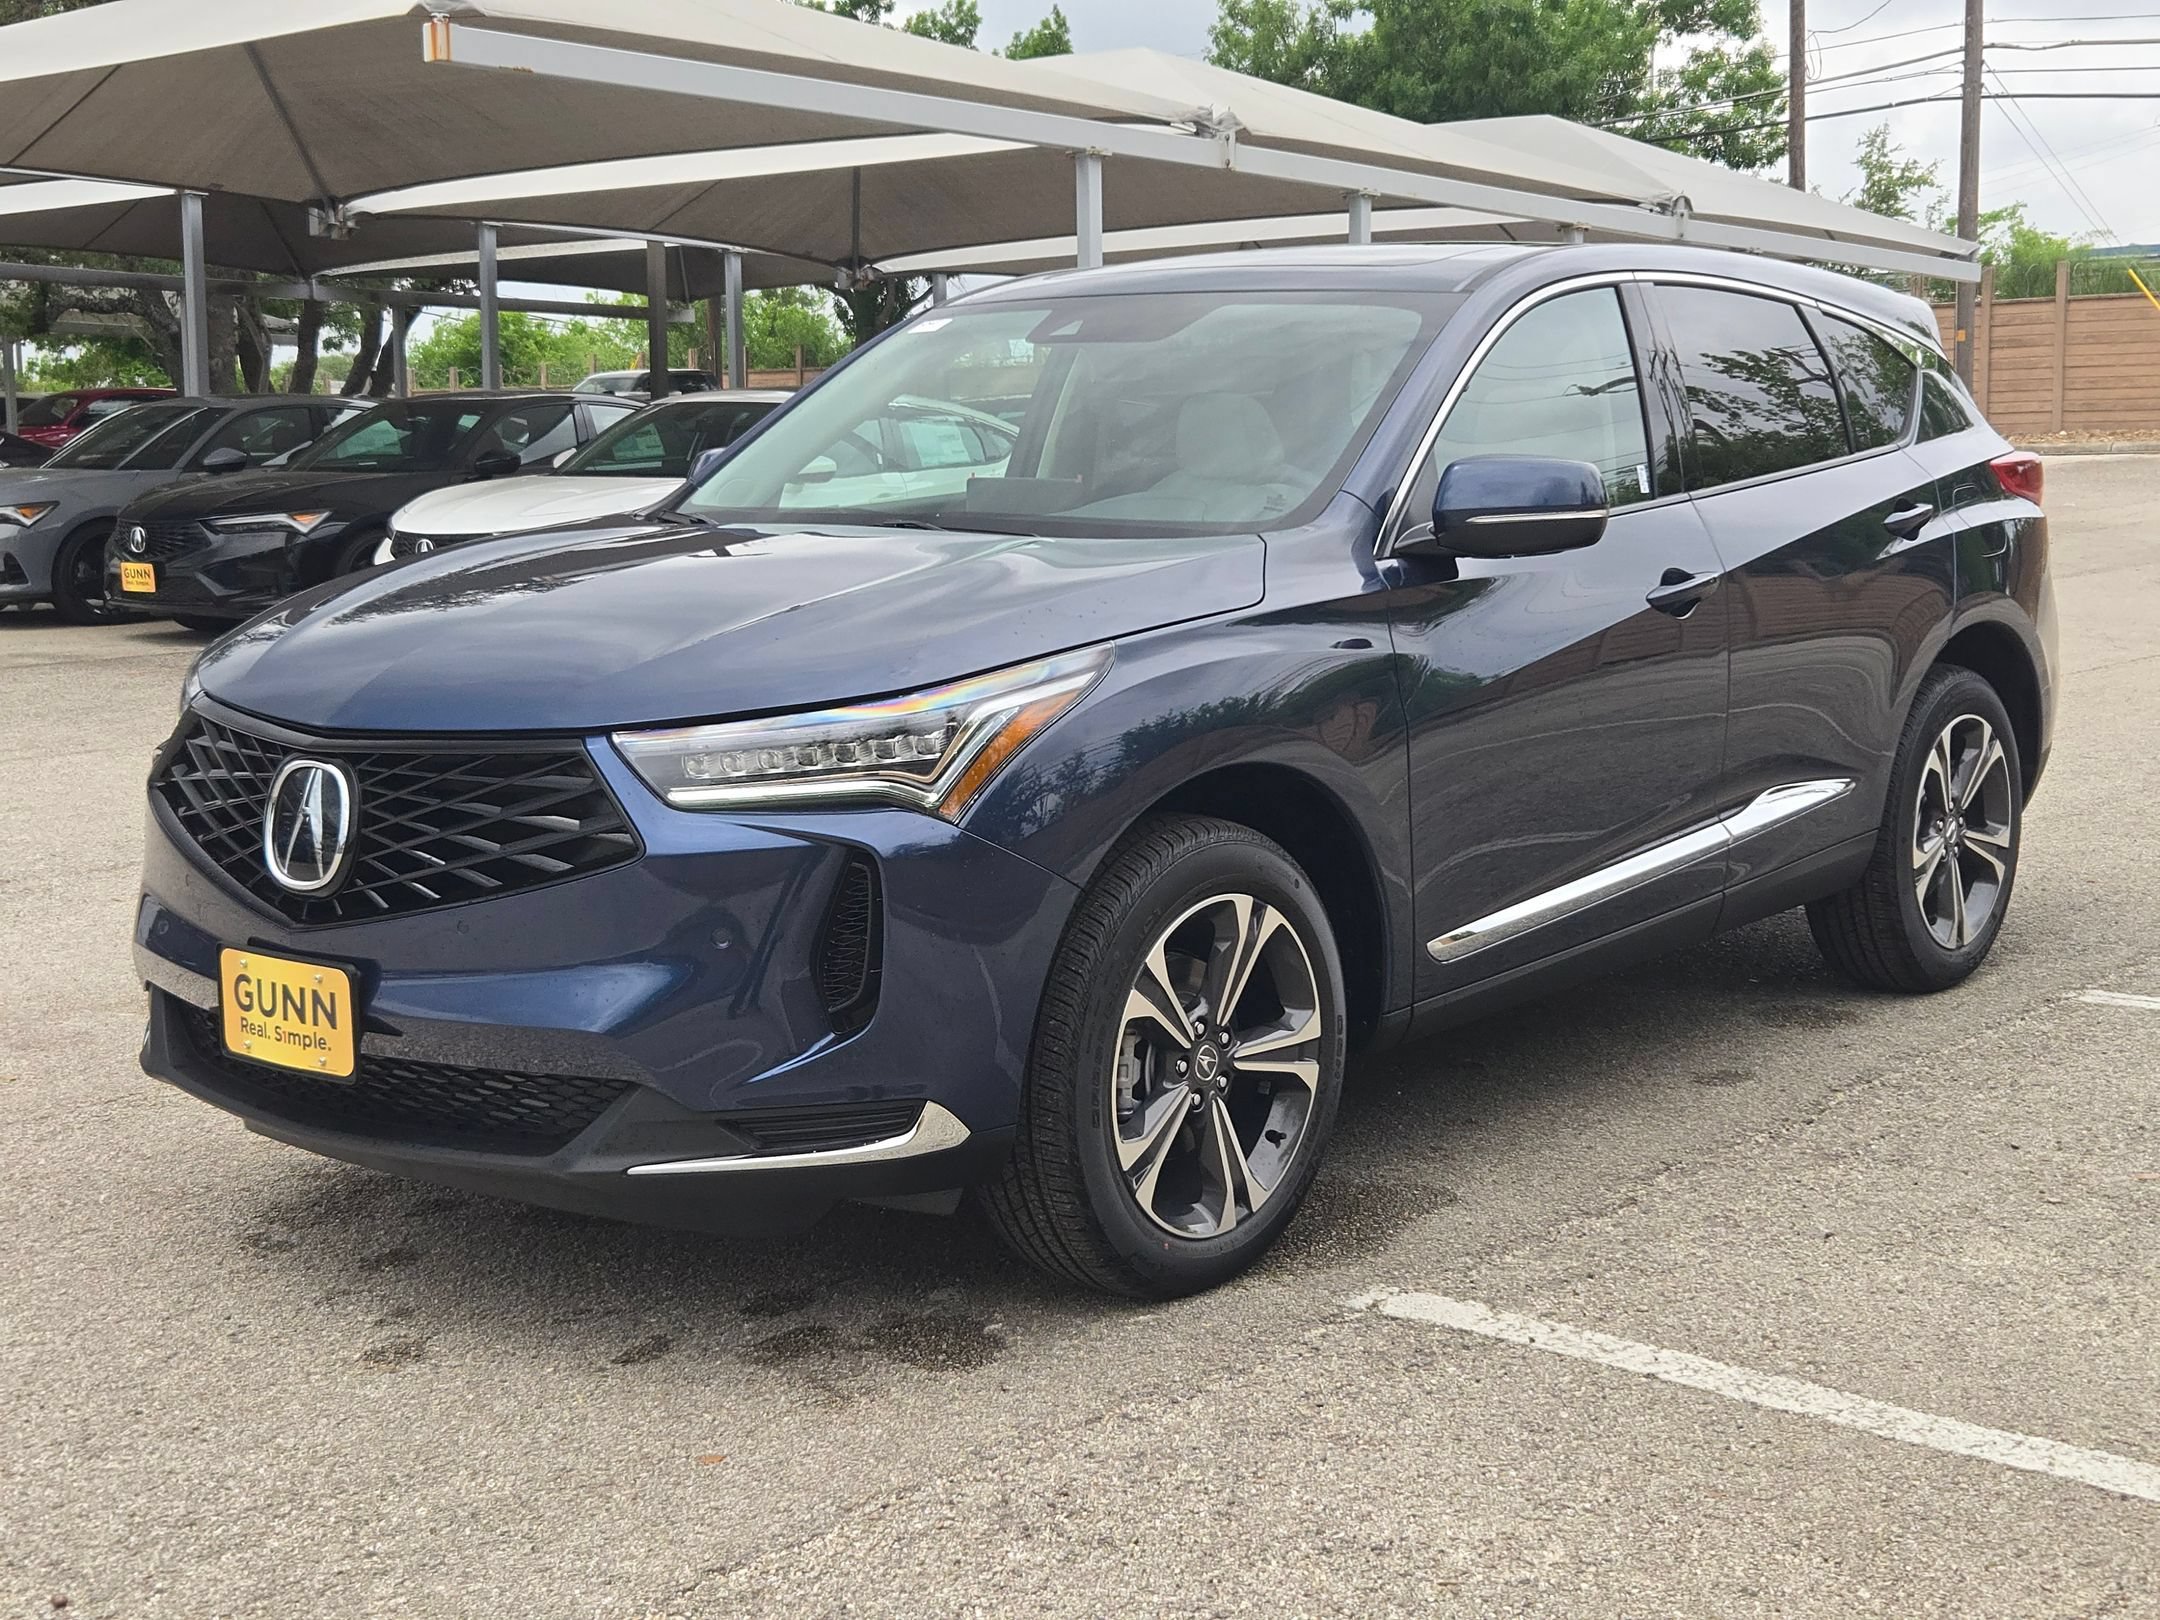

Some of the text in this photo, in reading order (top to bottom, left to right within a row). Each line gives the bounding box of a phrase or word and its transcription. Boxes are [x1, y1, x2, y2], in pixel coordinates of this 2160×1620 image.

[124, 568, 151, 579] GUNN
[234, 973, 337, 1030] GUNN
[240, 1016, 271, 1040] Real.
